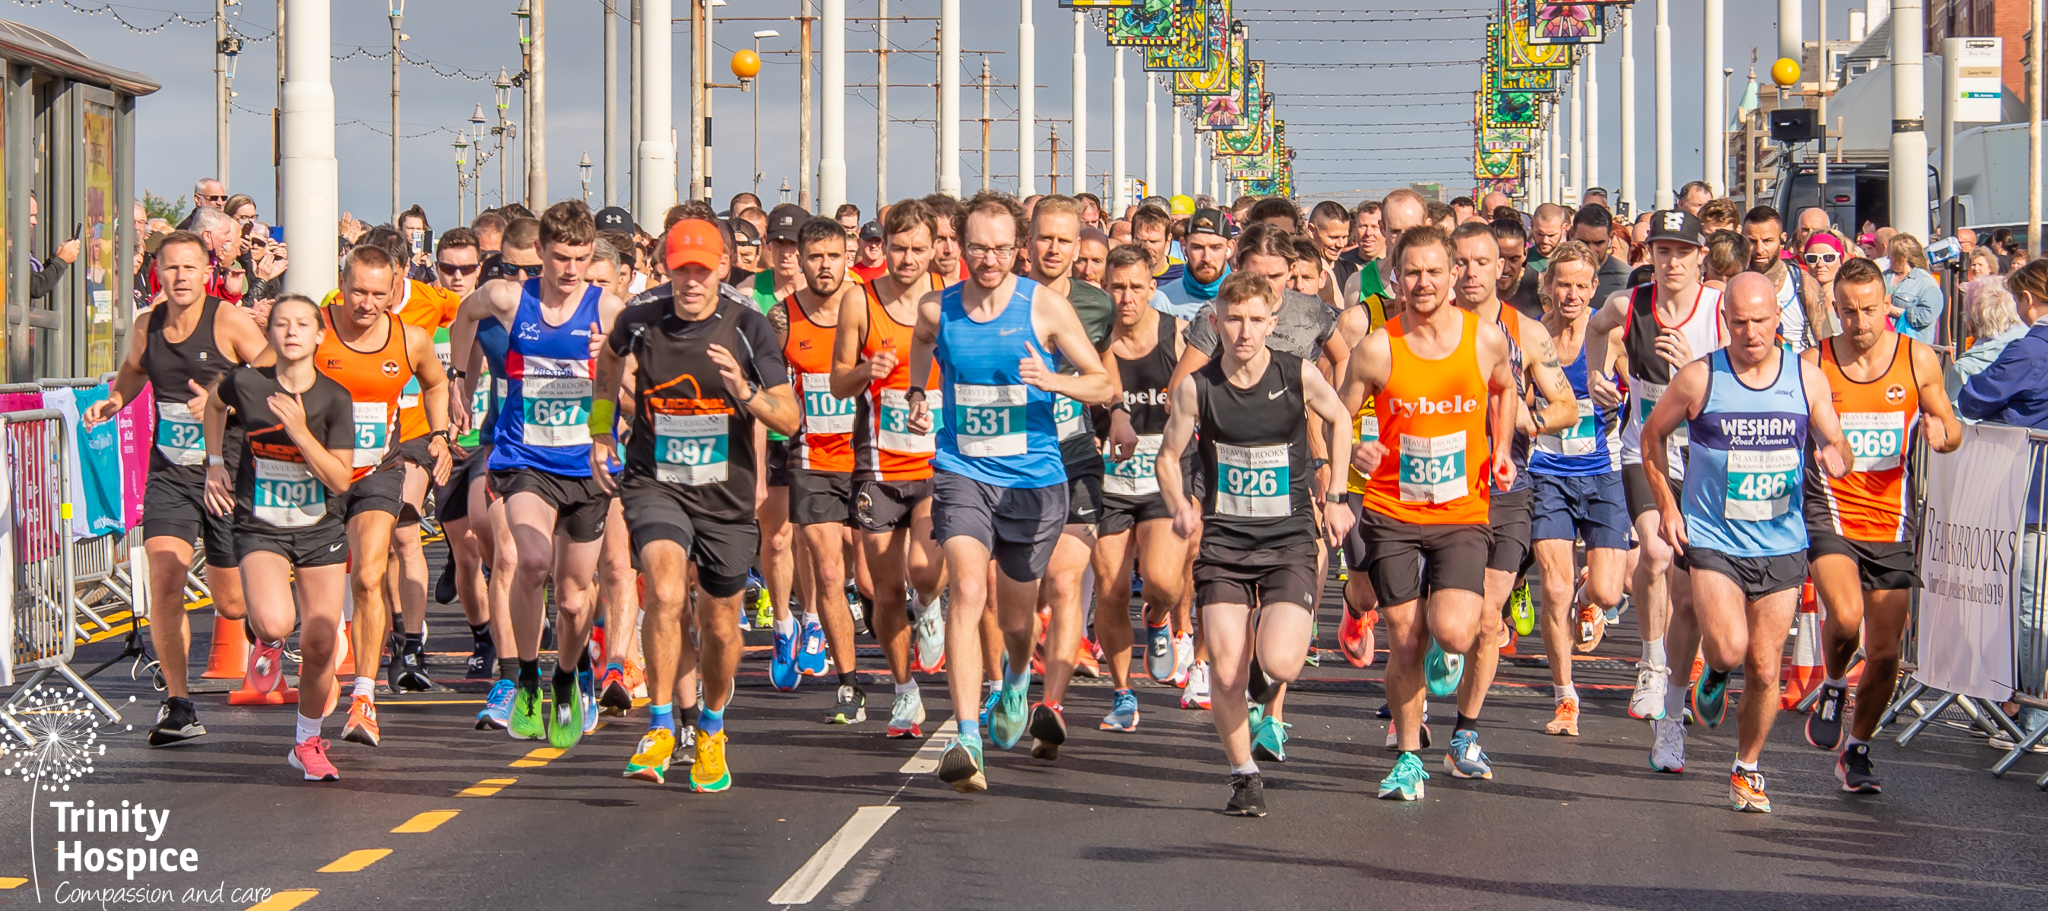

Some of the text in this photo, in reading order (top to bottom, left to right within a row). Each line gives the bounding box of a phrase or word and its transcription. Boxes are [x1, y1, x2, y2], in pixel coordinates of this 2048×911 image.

[533, 366, 574, 378] PRESTON
[526, 380, 589, 390] BEAVERBROOKS
[959, 388, 1023, 397] BEAVERBROOKS
[534, 399, 582, 425] 667
[965, 408, 1011, 434] 531
[171, 424, 201, 448] 32
[1721, 418, 1796, 436] WESHAM
[666, 438, 716, 465] 897
[1403, 435, 1463, 449] BEAVERBROOKS
[1730, 435, 1789, 446] Road Runners
[1847, 430, 1896, 456] 969
[1220, 447, 1284, 459] BEAVERBROOKS
[1732, 453, 1796, 463] BEAVERBROOKS
[1114, 455, 1156, 477] 235
[1410, 455, 1456, 483] 364
[260, 480, 317, 506] 1091
[1228, 468, 1277, 495] 926
[1738, 473, 1787, 500] 486
[1984, 582, 2004, 606] 1919
